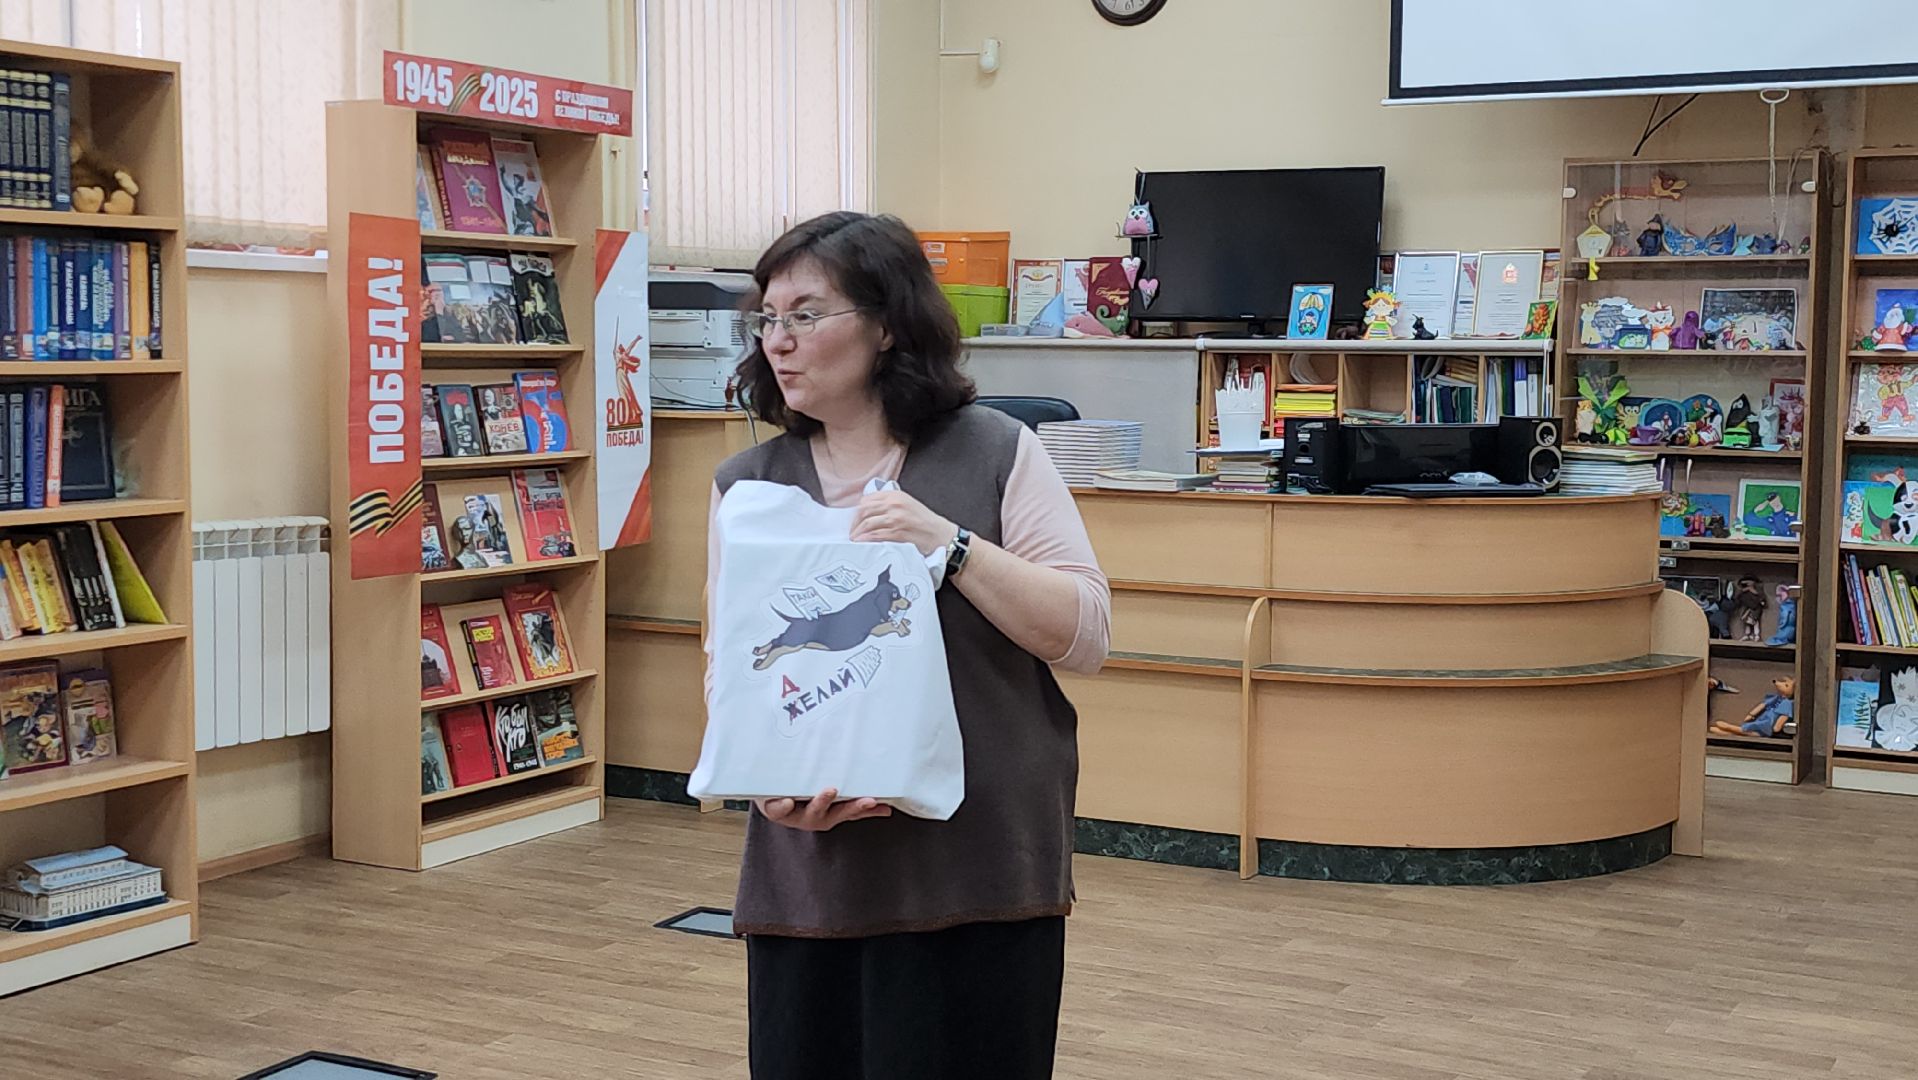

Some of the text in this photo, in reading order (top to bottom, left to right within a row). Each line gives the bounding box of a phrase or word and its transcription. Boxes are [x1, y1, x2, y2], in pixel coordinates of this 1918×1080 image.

[392, 60, 454, 107] 1945
[479, 72, 539, 119] 2025
[368, 257, 410, 464] ПОБЕДА!
[606, 398, 626, 425] 80
[606, 430, 644, 447] ПОБЕДА!
